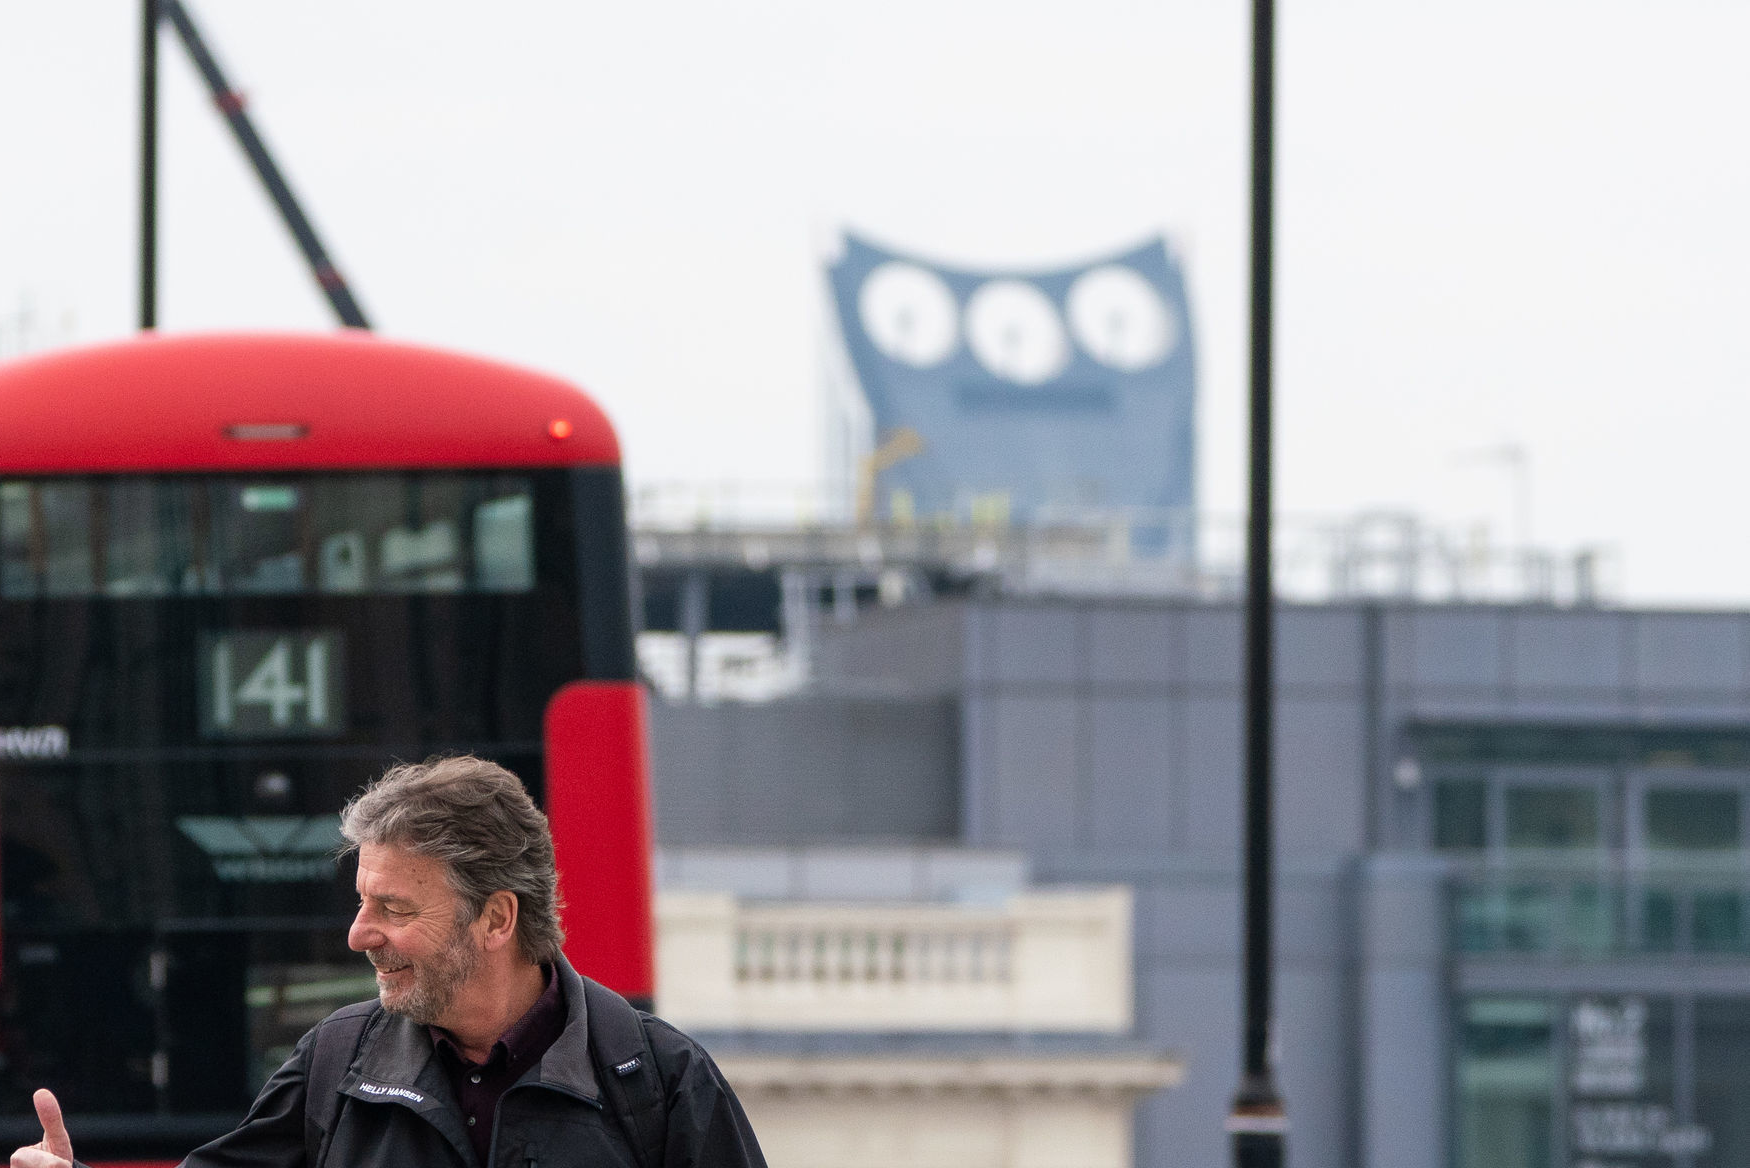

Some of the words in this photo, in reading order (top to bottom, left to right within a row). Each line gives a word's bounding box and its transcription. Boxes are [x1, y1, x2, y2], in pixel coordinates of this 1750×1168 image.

[213, 638, 328, 726] 141
[359, 1082, 387, 1095] HELLY
[386, 1087, 424, 1103] HANSEN
